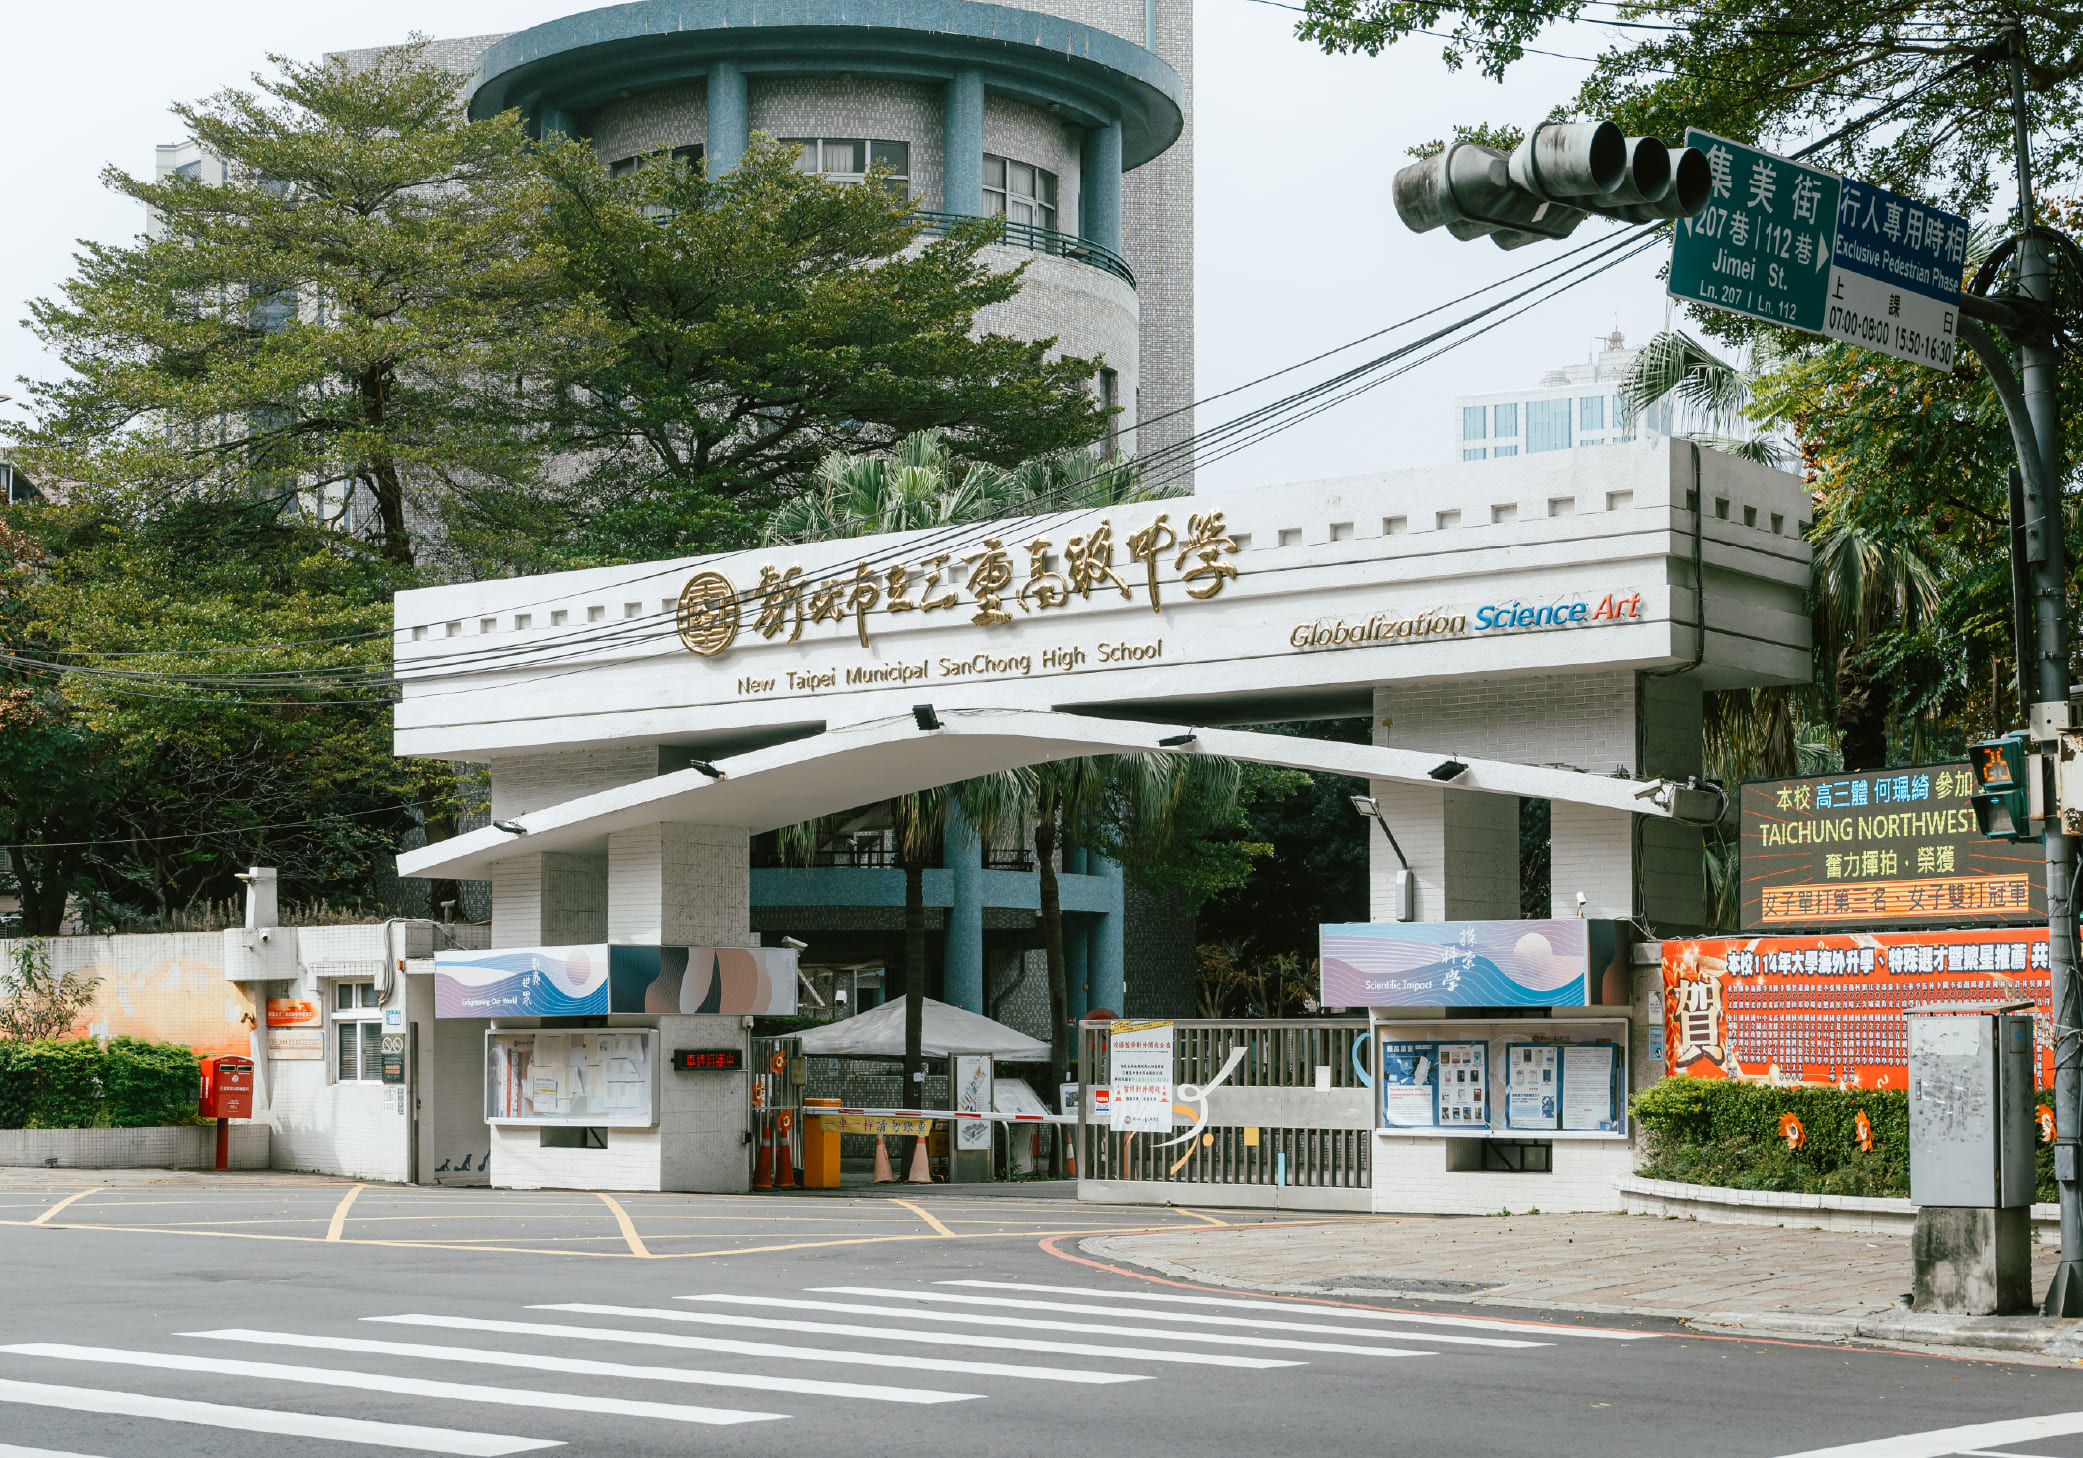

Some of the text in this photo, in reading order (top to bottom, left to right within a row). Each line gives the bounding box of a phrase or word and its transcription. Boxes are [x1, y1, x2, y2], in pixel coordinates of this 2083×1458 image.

[1705, 143, 1823, 225] 集美街
[1840, 184, 1966, 265] 行人專用時相
[1712, 247, 1788, 291] Jimei St.
[1836, 234, 1959, 294] Exclusive Pedestrian Phase
[1700, 280, 1797, 321] Ln. 207 Ln. 112
[1829, 305, 1951, 366] 07:00-08:00 15:50-16:30
[1291, 592, 1641, 648] Globalization Science Art
[737, 637, 1163, 695] New Taipei Municipal SanChong High School
[1776, 785, 1811, 812] 本校
[1815, 779, 1869, 810] 高三體
[1935, 771, 1973, 799] 參加
[1759, 808, 1978, 847] TAICHUNG NORTHWEST
[1440, 946, 1462, 992] 科學
[1458, 926, 1477, 970] 探索
[521, 976, 532, 1007] 世界
[1365, 980, 1432, 992] Scientific Impact
[1673, 977, 1725, 1069] 賀
